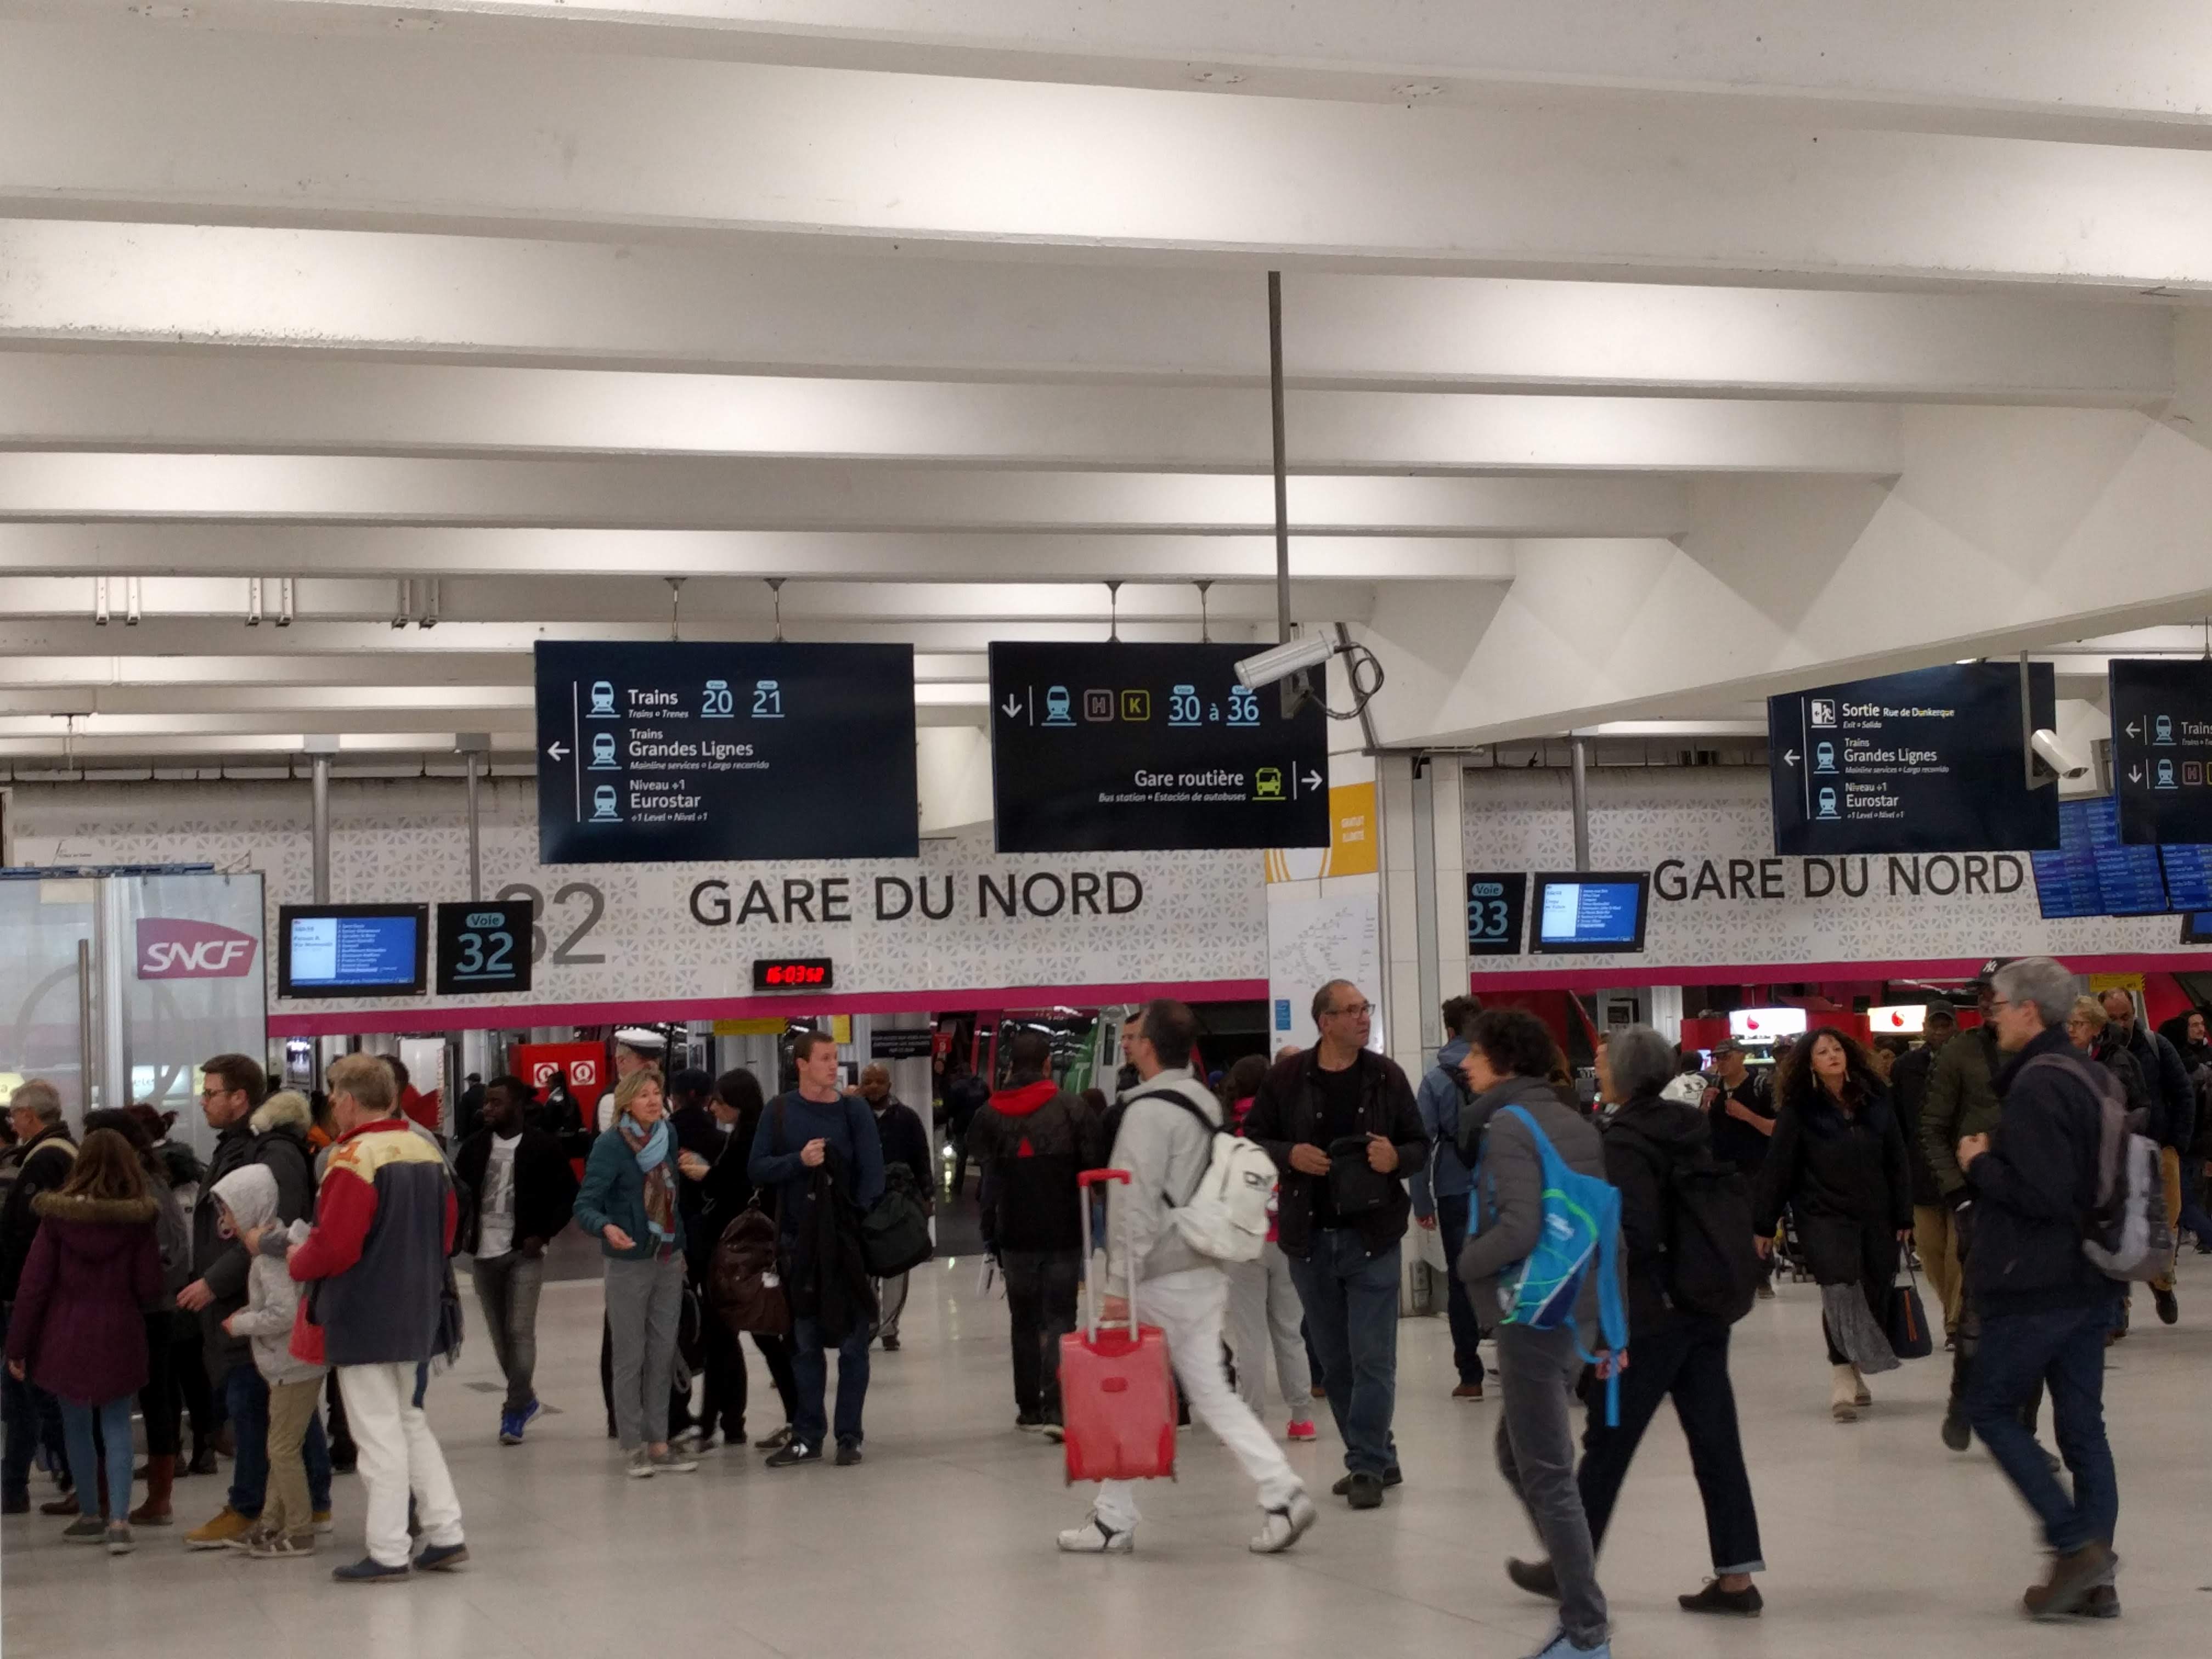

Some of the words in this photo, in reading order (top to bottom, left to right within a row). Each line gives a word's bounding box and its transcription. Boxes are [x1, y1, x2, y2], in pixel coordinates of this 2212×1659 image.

[628, 689, 678, 705] Trains
[702, 690, 733, 713] 20
[753, 690, 780, 713] 21
[1092, 696, 1106, 714] H
[1129, 697, 1142, 713] K
[1169, 696, 1200, 721] 30
[1209, 703, 1220, 721] à
[1227, 696, 1259, 721] 36
[628, 709, 653, 718] Trains
[662, 709, 689, 718] Trenes
[1842, 703, 1880, 717] Sortie
[1883, 707, 1899, 716] Rue
[1900, 708, 1910, 716] de
[1912, 707, 1955, 719] Dunkerque
[629, 728, 663, 740] Trains
[629, 741, 697, 757] Grandes
[702, 740, 754, 760] Lignes
[1844, 738, 1870, 747] Trains
[1844, 748, 1895, 762] Grandes
[1898, 748, 1937, 765] Lignes
[668, 761, 699, 770] services
[630, 779, 669, 791] Niveau
[672, 778, 685, 791] +1
[1135, 770, 1173, 787] Gare
[1179, 769, 1244, 787] routière
[1845, 782, 1875, 792] Niveau
[631, 793, 701, 809] Eurostar
[1099, 792, 1114, 802] Bus
[1116, 792, 1146, 802] station
[1192, 792, 1202, 801] de
[1846, 794, 1899, 808] Eurostar
[644, 812, 666, 822] Level
[1654, 859, 1785, 901] GARE
[1803, 857, 1868, 898] DU
[1888, 854, 2024, 896] NORD
[1475, 885, 1499, 895] Voie
[690, 878, 851, 927] GARE
[877, 875, 954, 921] DU
[979, 872, 1143, 917] NORD
[472, 915, 500, 926] Voie
[1468, 900, 1509, 936] 33
[142, 940, 250, 972] SNCF
[455, 932, 514, 973] 32
